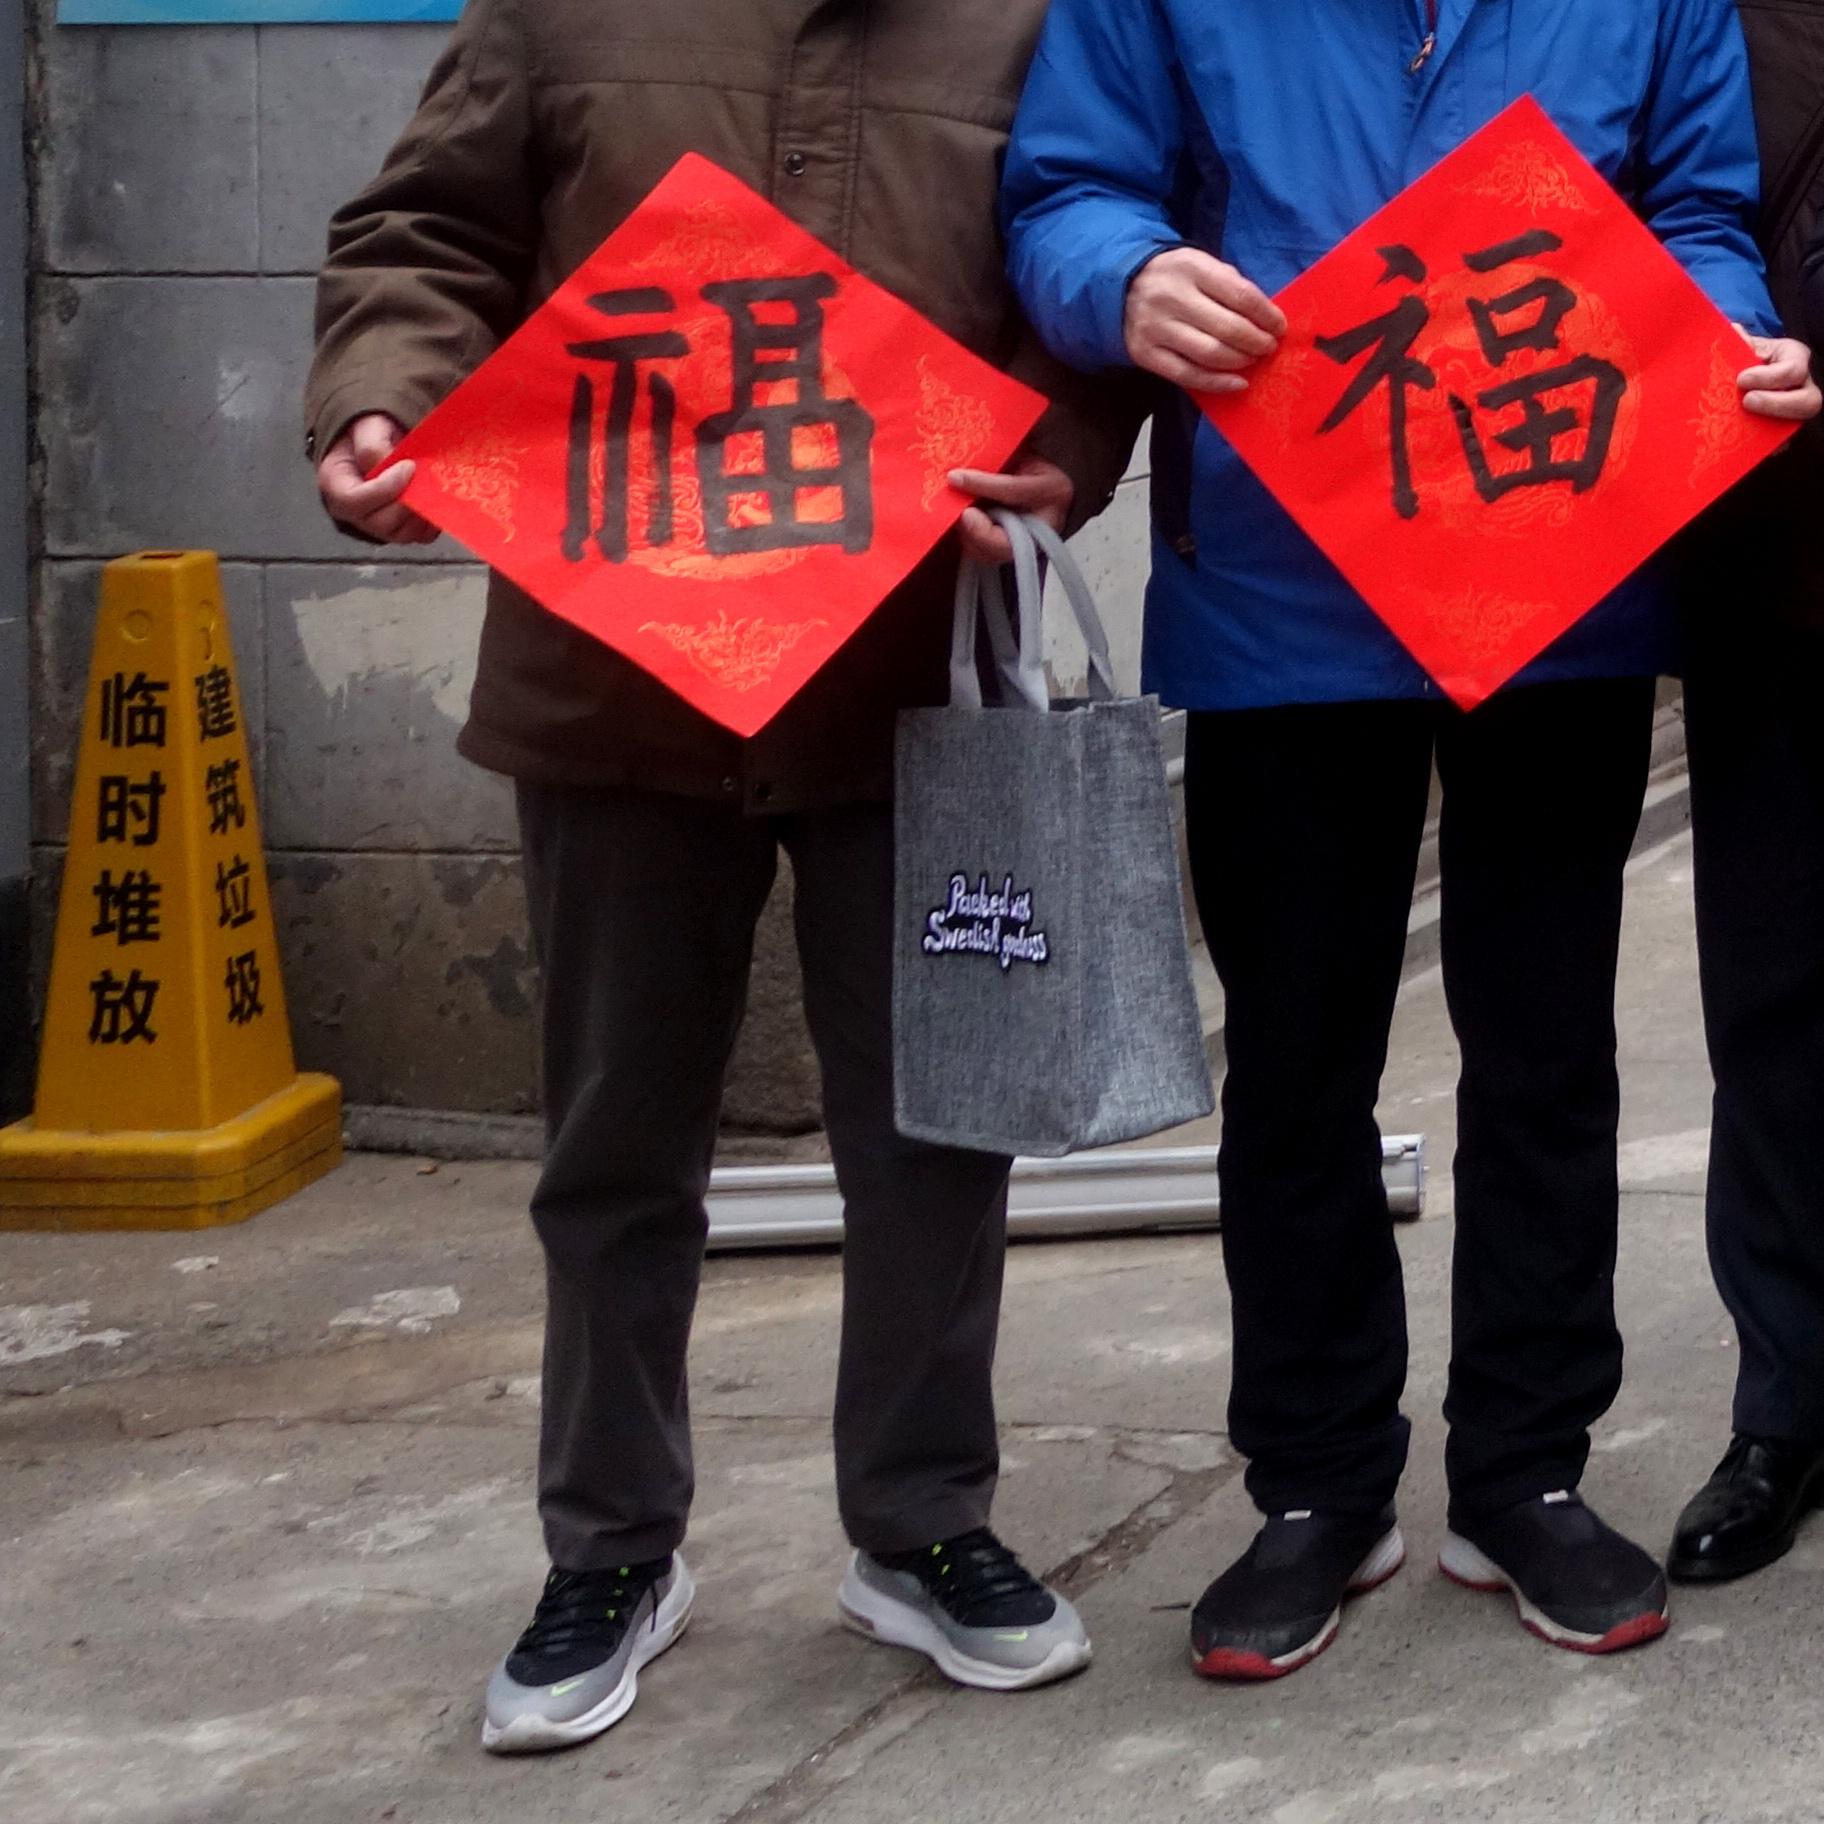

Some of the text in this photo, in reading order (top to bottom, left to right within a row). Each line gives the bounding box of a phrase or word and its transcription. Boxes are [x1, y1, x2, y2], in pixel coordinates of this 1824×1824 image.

[562, 270, 875, 562] 福
[1315, 230, 1628, 517] 福
[88, 671, 171, 1045] 临时堆放
[196, 665, 265, 1026] 建筑垃圾
